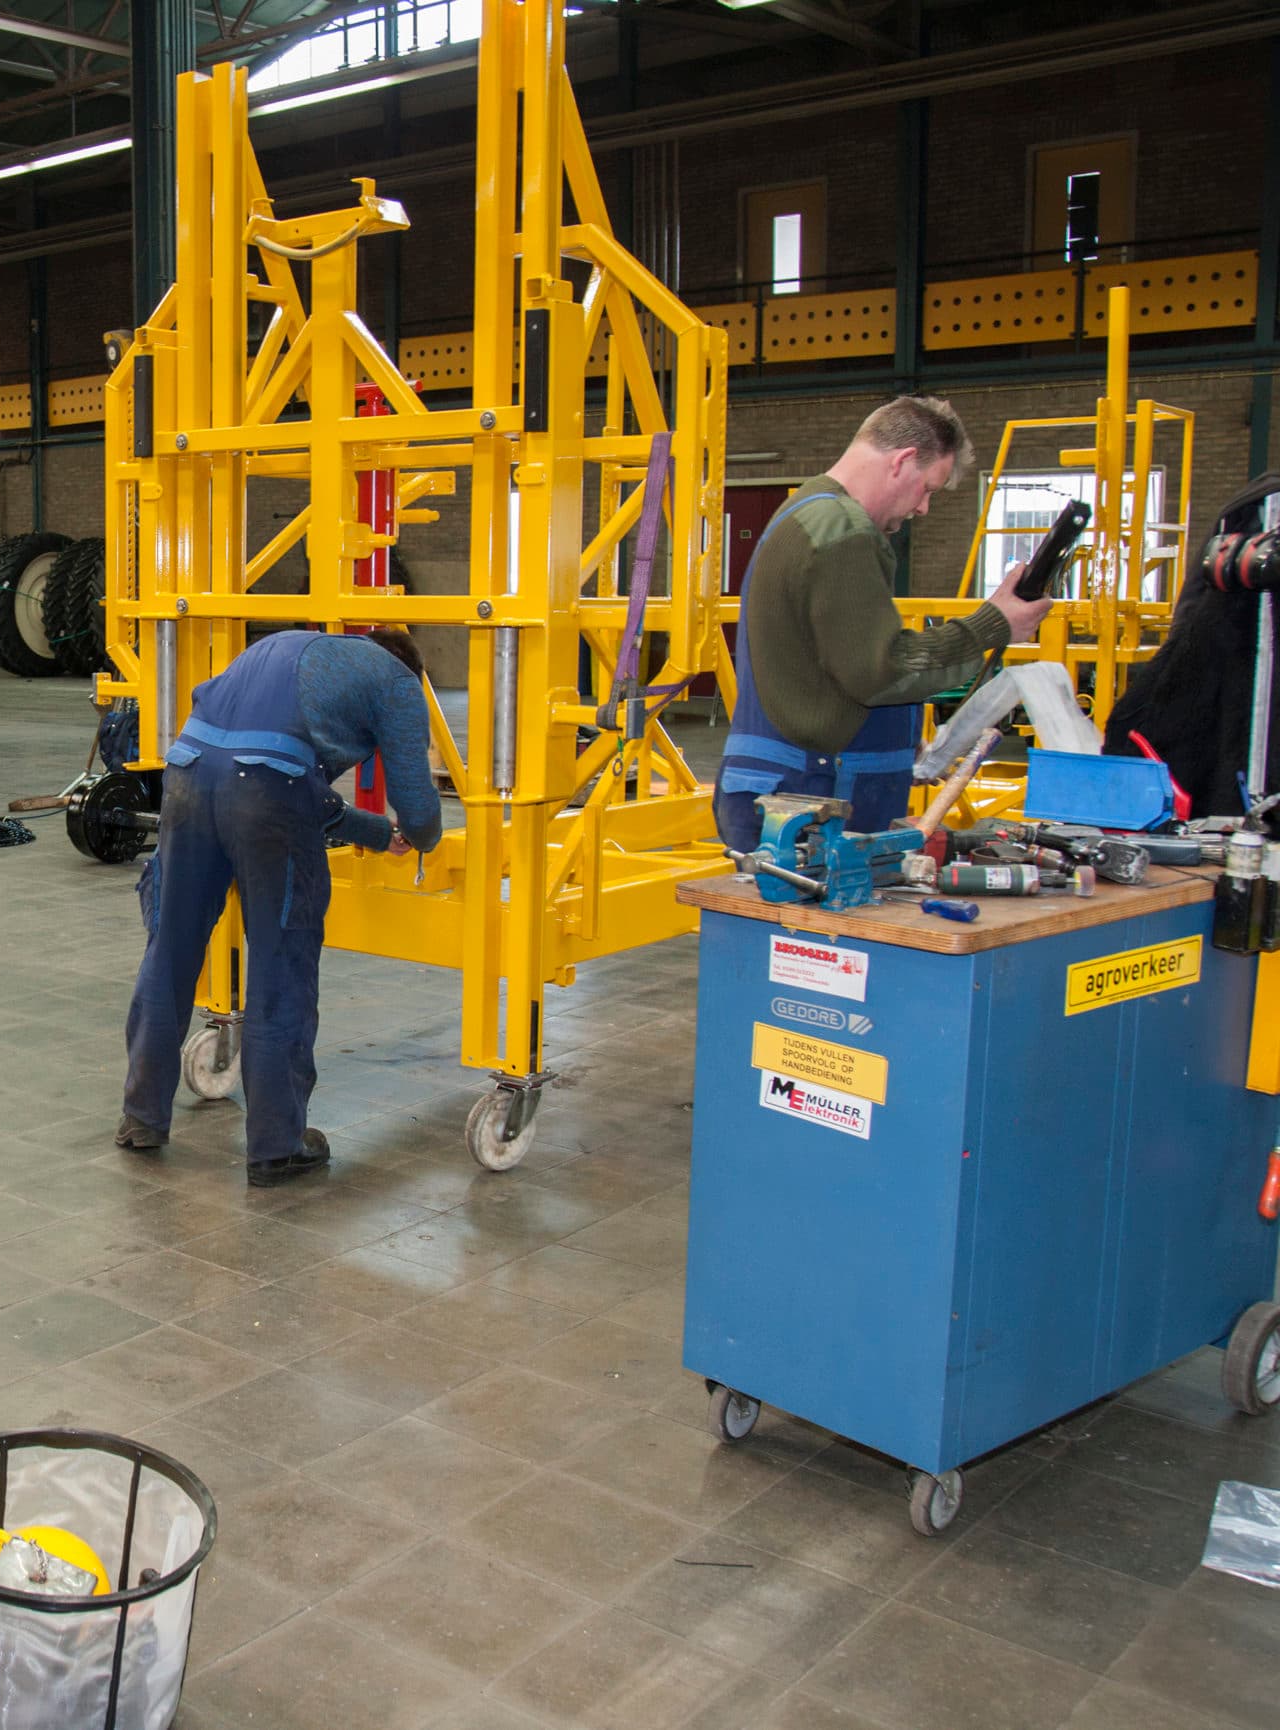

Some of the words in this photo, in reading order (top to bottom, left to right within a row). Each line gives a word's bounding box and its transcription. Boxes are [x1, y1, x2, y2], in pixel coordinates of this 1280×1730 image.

[1086, 952, 1184, 996] agroverkeer
[777, 1001, 840, 1025] GEDORE
[782, 1047, 836, 1070] SPOORVOLG
[841, 1064, 854, 1074] OP
[820, 1047, 855, 1064] VULLEN
[781, 1058, 853, 1086] HANDBEDIENING
[805, 1093, 861, 1118] MÜLLER
